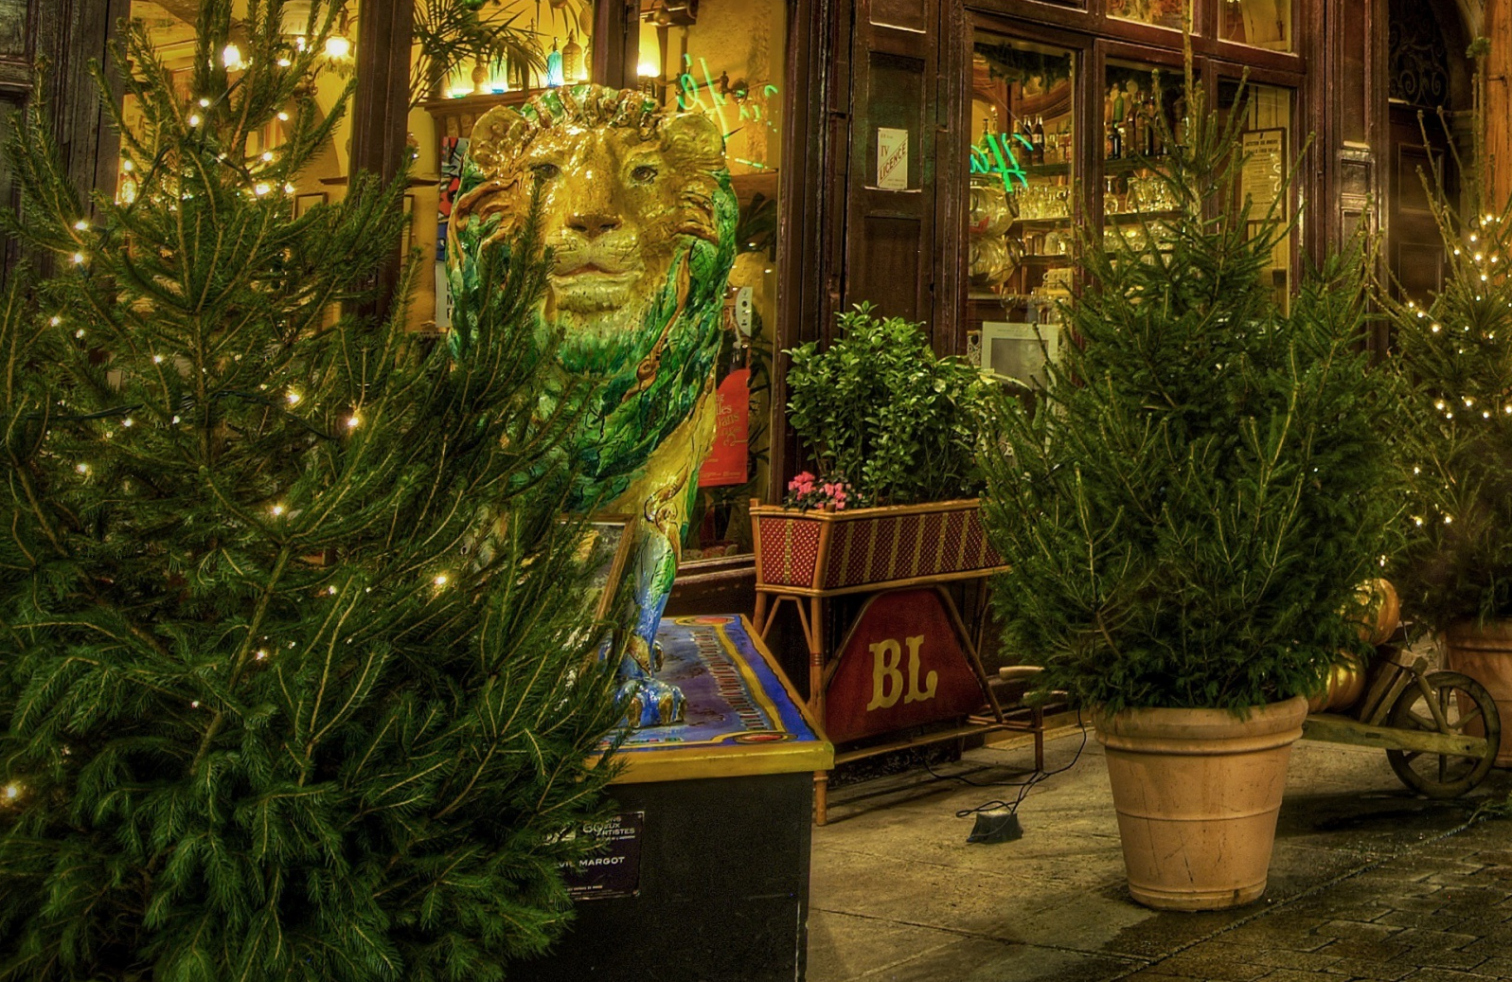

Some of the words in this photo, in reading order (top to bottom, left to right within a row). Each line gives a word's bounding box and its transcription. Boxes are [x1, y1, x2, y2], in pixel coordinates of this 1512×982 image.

[880, 142, 907, 180] LICENCE
[866, 634, 939, 712] BL
[579, 856, 625, 867] MARGOT
